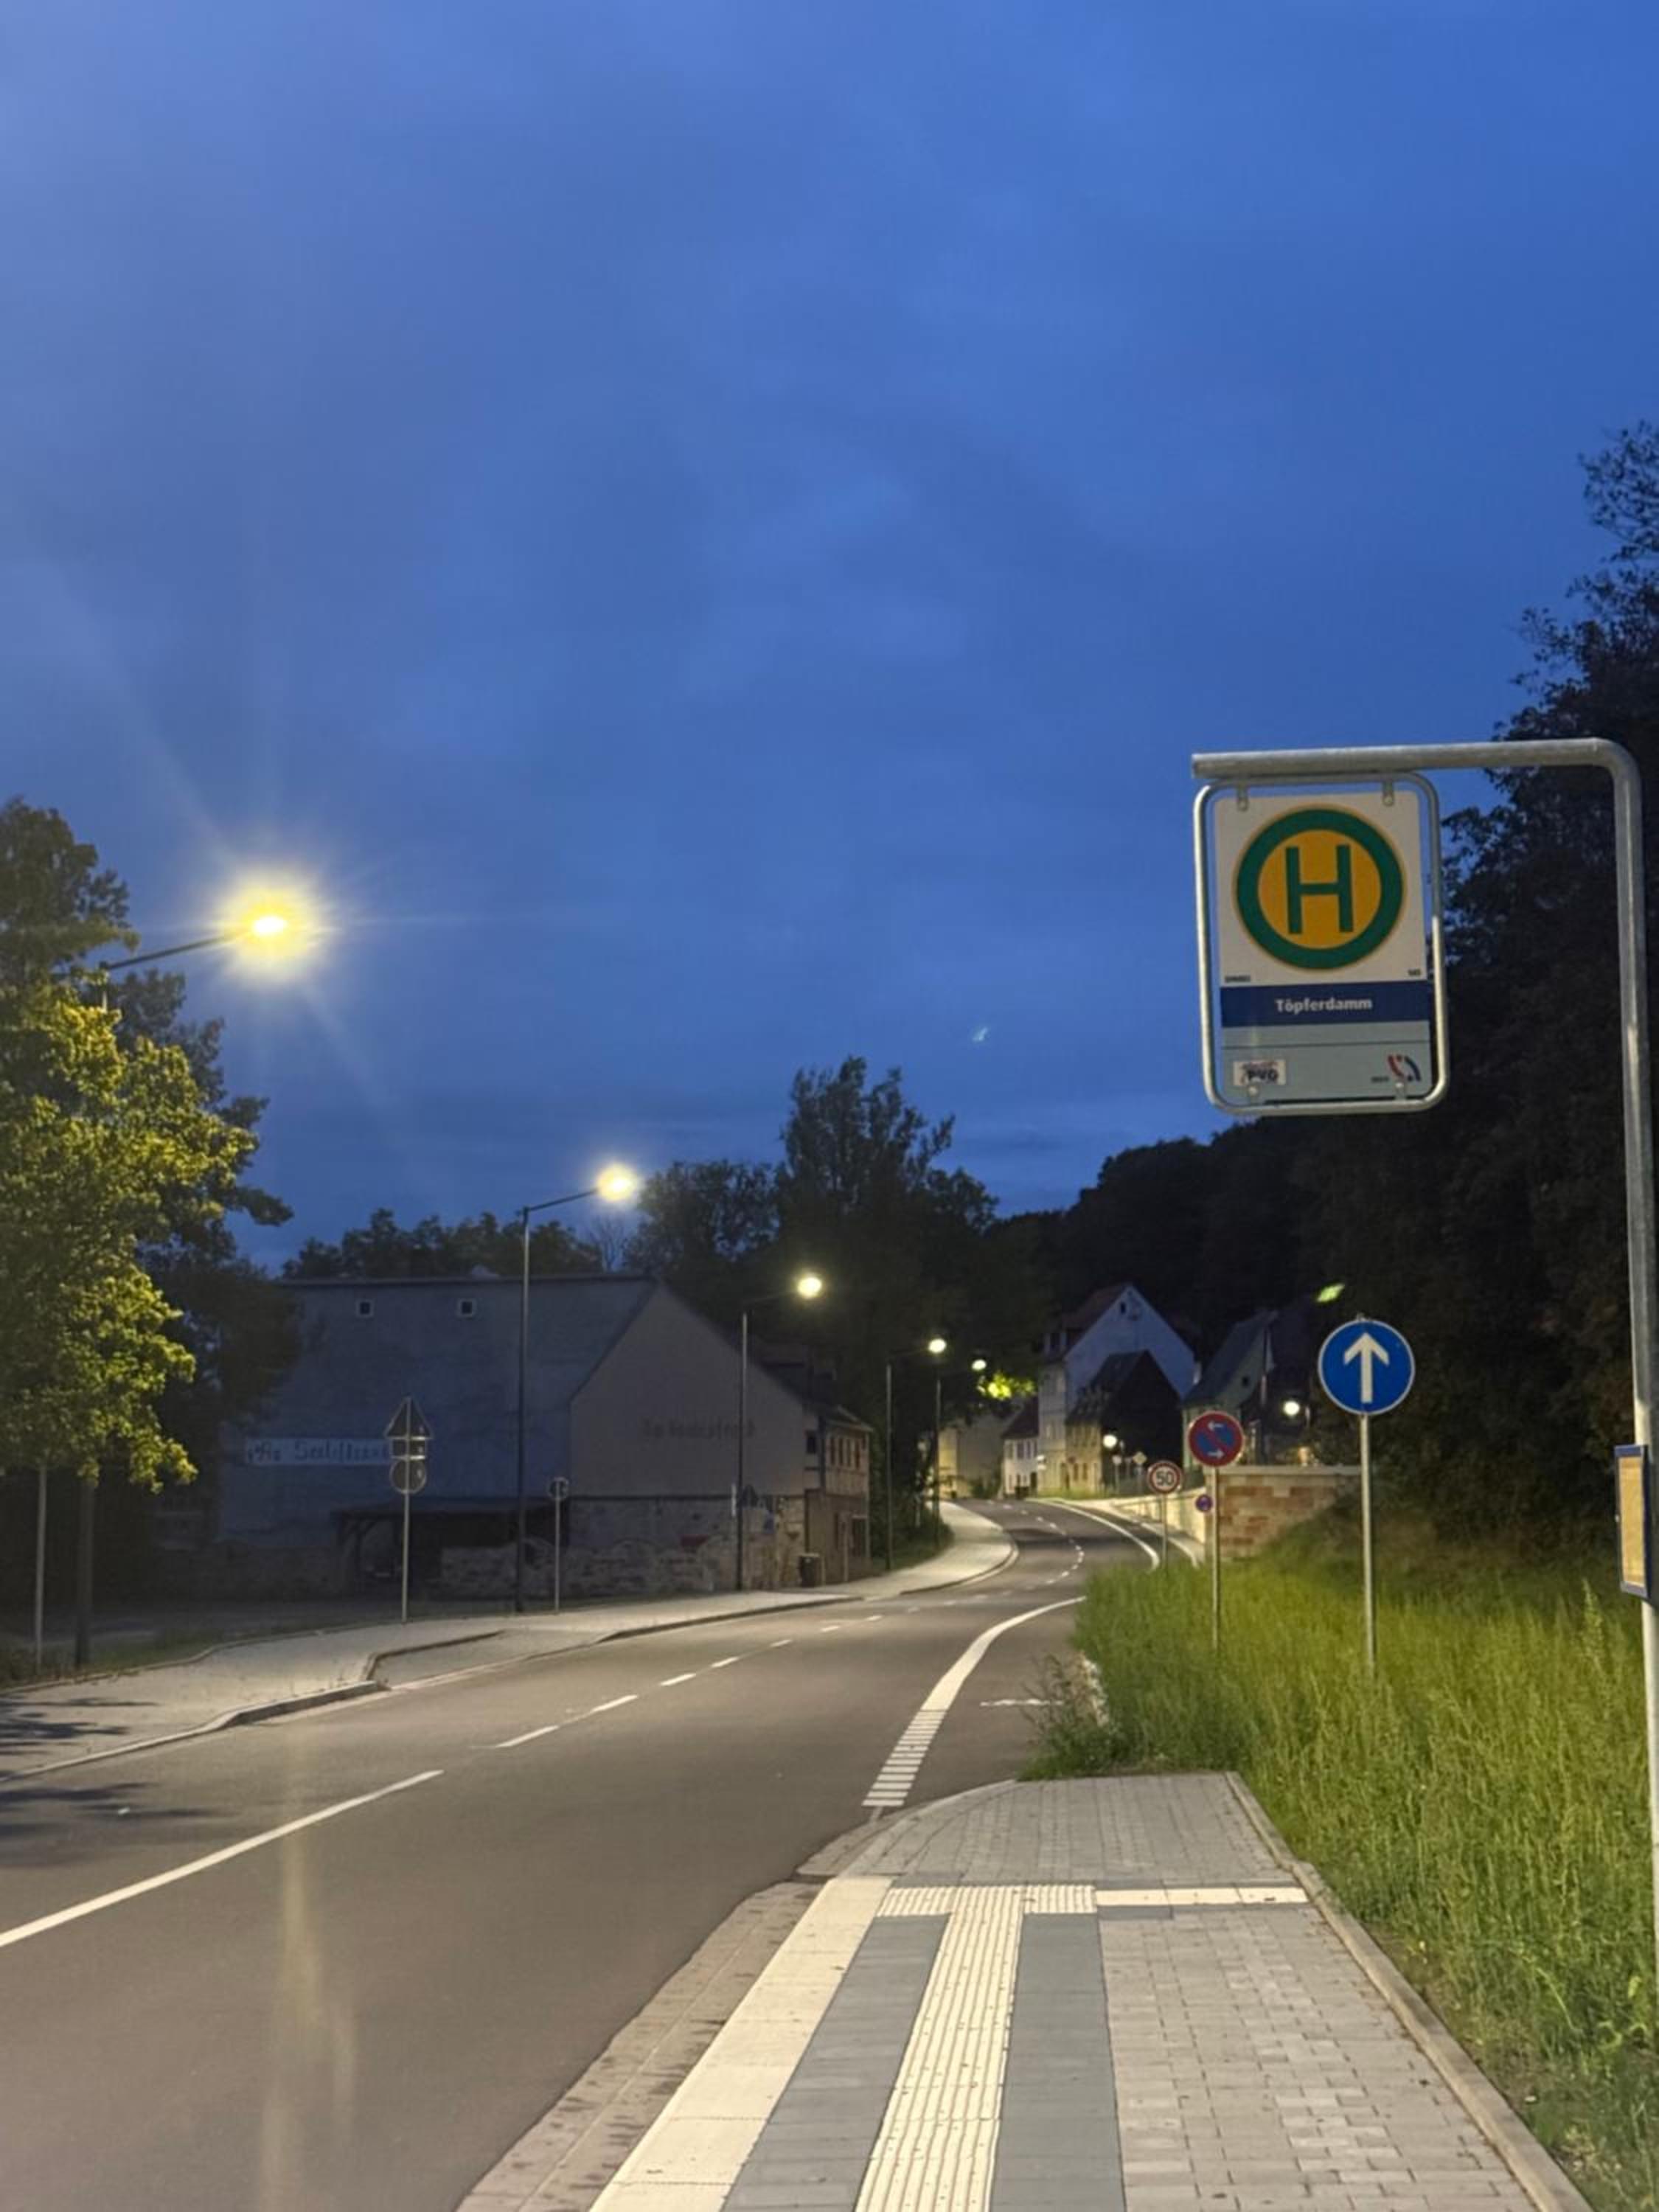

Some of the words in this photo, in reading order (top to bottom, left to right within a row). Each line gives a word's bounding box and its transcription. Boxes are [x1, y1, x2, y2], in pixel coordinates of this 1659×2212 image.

[1285, 844, 1354, 934] H
[1276, 997, 1372, 1015] Töpferdamm
[1156, 1470, 1174, 1486] 50
